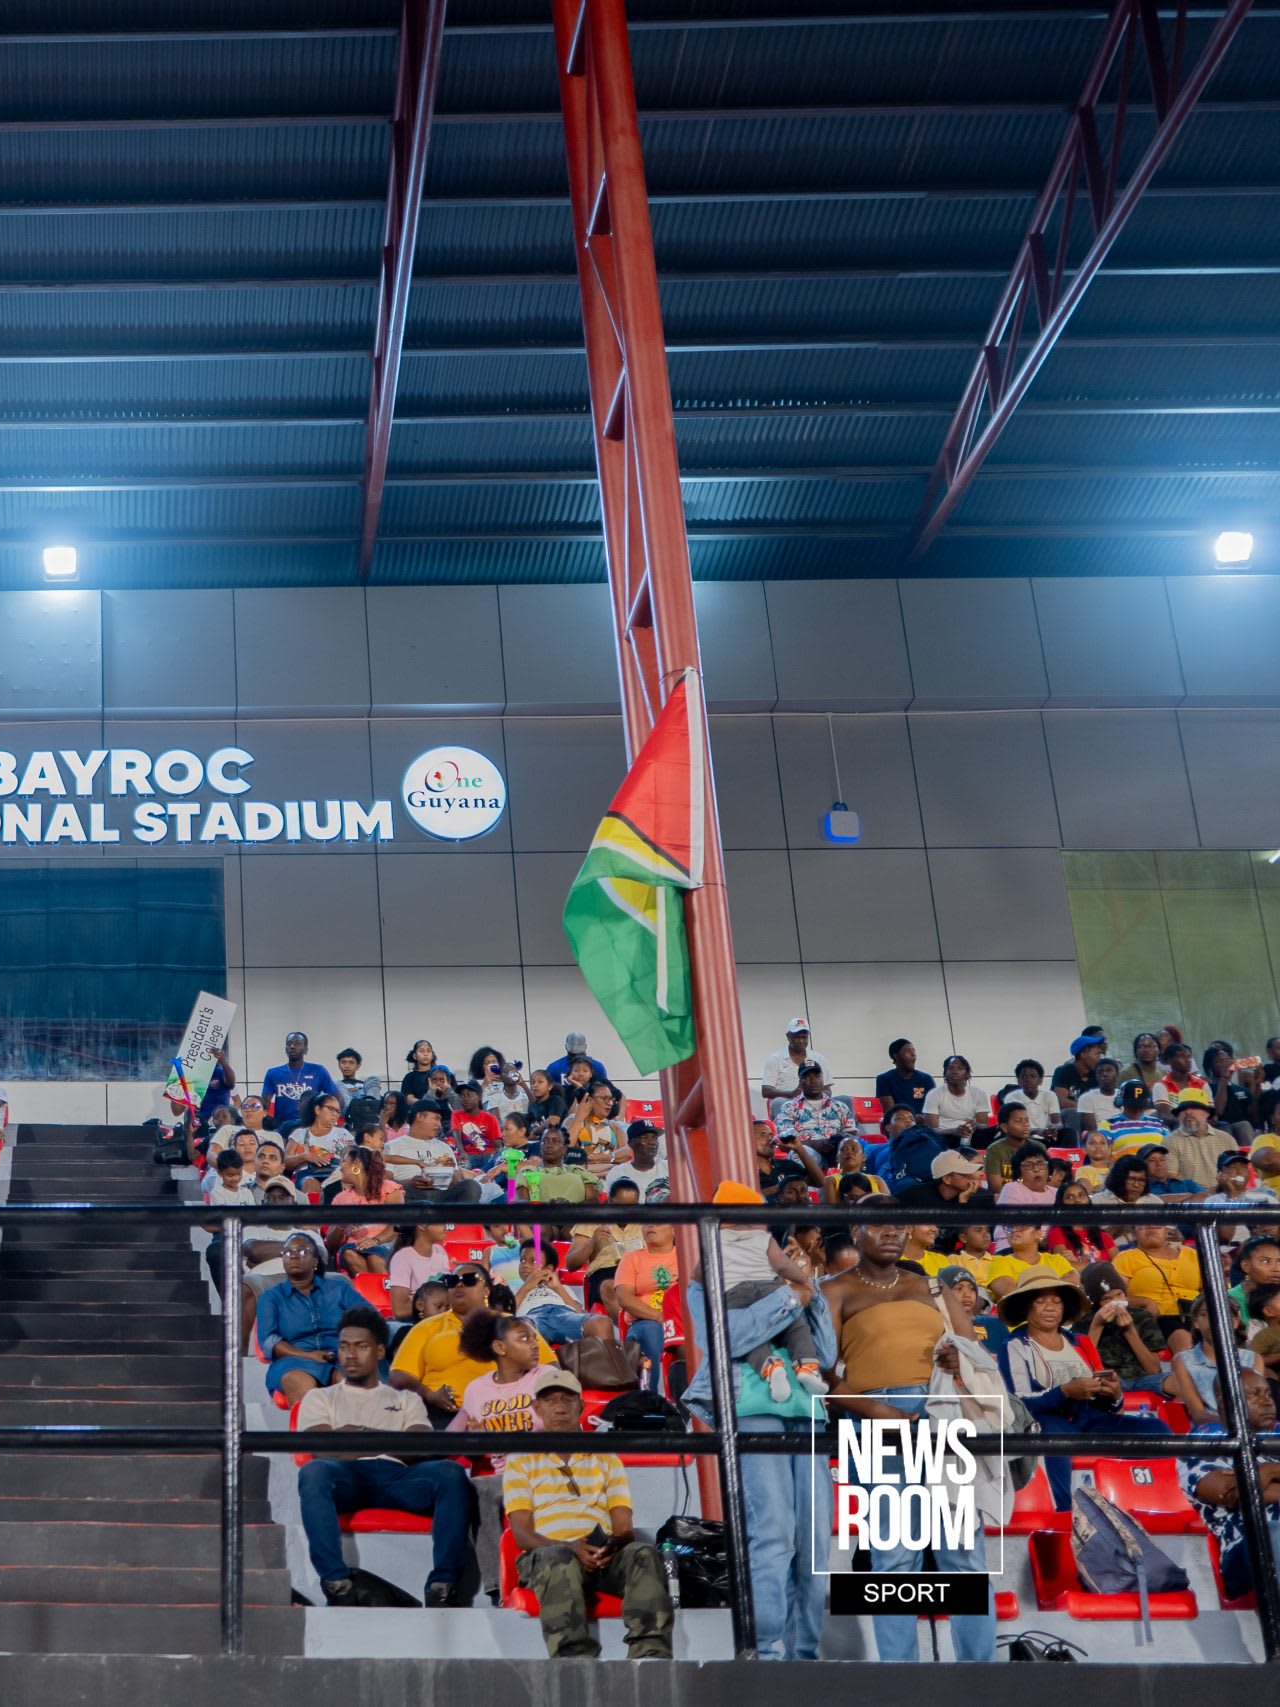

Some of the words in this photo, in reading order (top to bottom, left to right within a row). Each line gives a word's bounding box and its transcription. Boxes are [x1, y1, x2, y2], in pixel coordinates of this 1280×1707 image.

[424, 760, 483, 793] One
[407, 790, 502, 815] Guyana
[134, 800, 394, 843] STADIUM
[181, 1007, 214, 1070] President's
[1134, 1087, 1143, 1099] P
[470, 1250, 483, 1260] 30
[1132, 1467, 1153, 1484] 31
